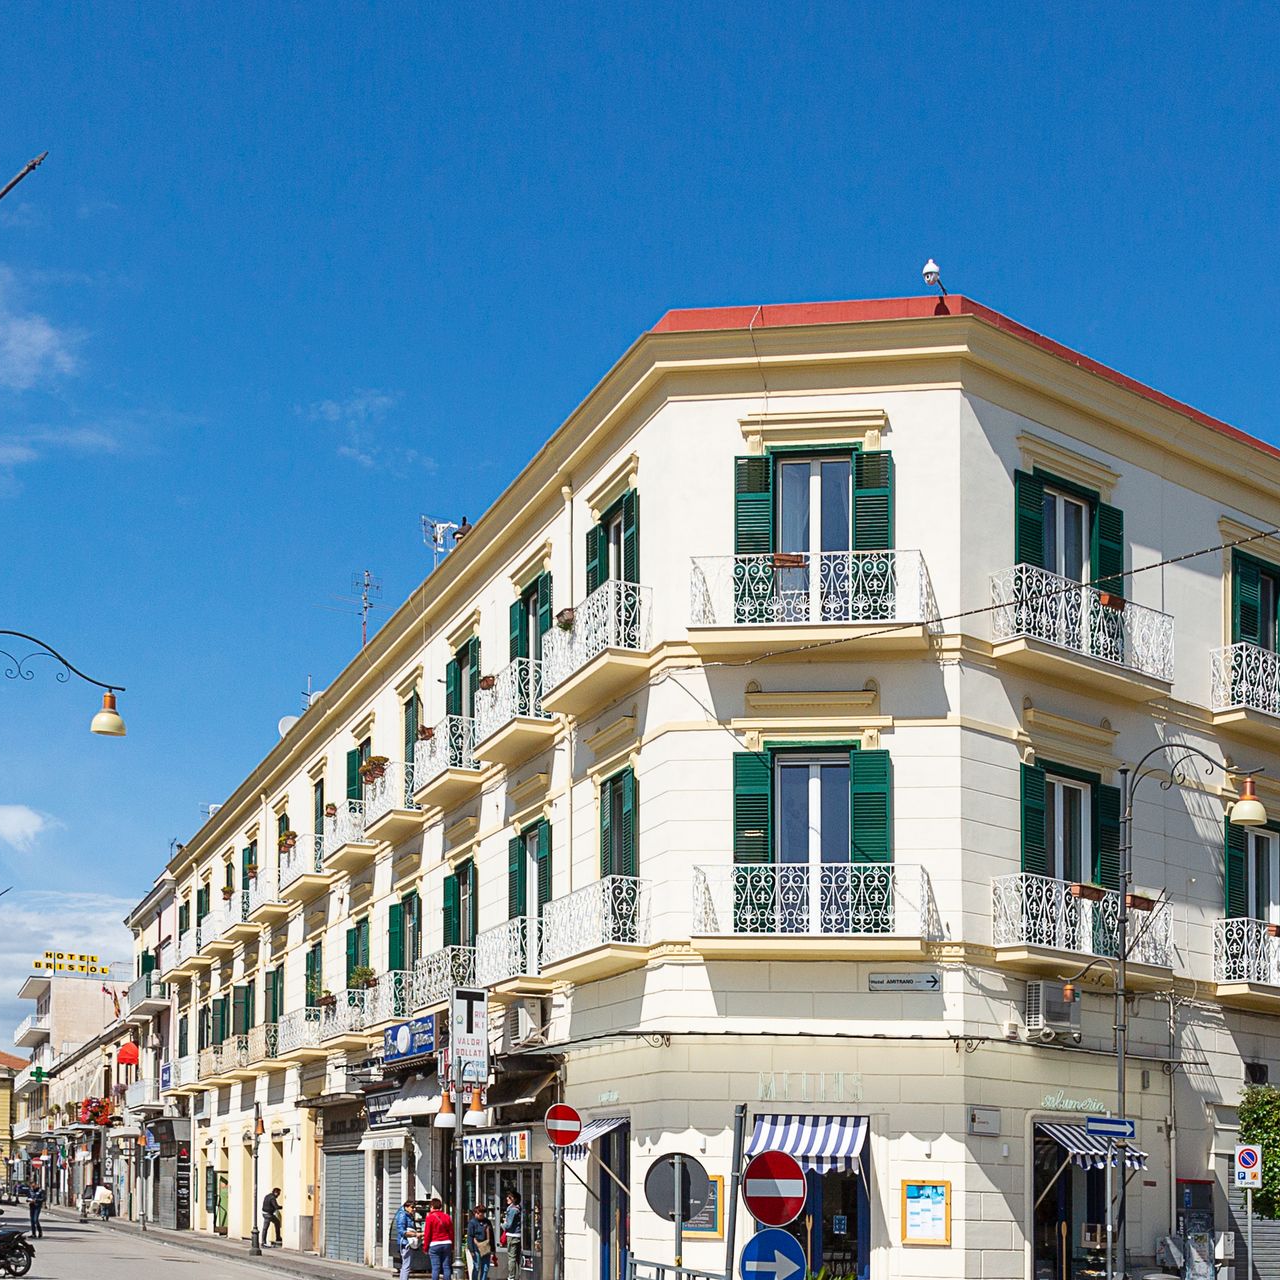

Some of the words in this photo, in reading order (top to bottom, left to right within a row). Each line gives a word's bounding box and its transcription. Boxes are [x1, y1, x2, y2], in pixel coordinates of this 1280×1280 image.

[45, 952, 97, 962] HOTEL
[34, 962, 108, 974] BRISTOL
[456, 990, 485, 1034] T
[457, 1038, 483, 1046] VALORI
[455, 1048, 485, 1057] BOLLATI
[463, 1135, 517, 1161] TABACCHI
